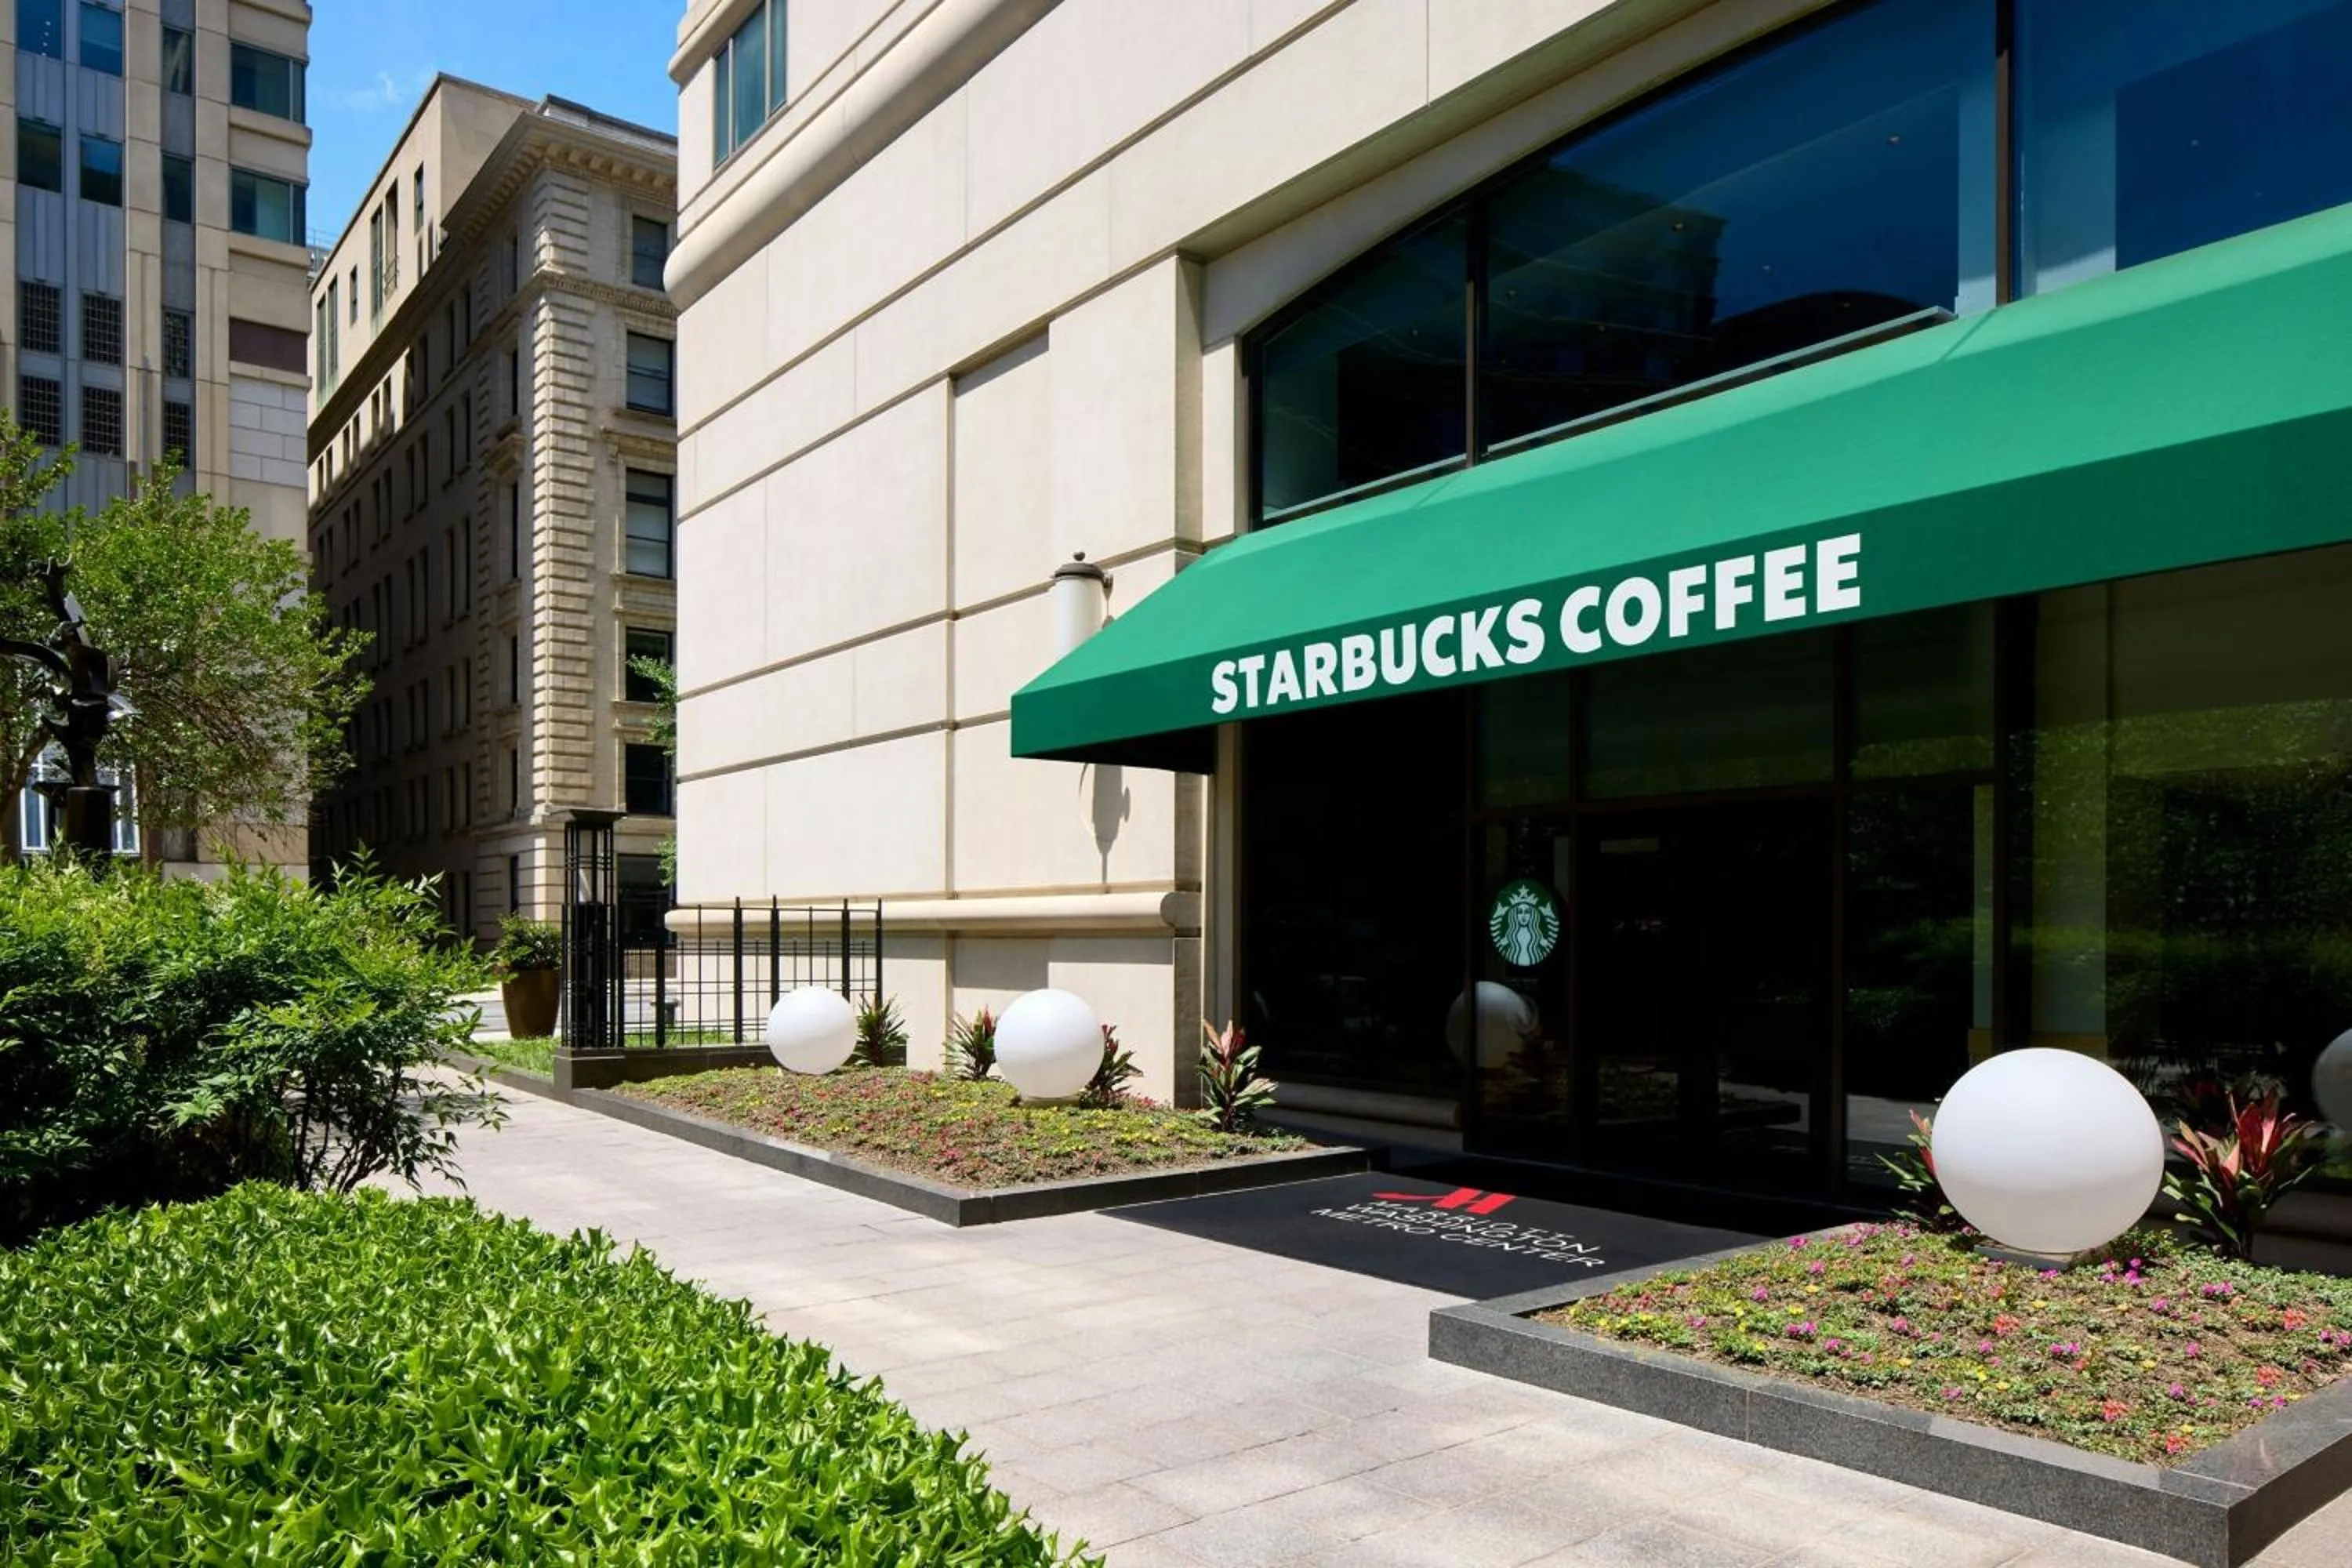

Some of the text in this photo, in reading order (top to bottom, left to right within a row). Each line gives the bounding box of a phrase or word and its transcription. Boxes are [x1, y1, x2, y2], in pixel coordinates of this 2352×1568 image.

[1211, 533, 1860, 714] STARBUCKS COFFEE
[1311, 1208, 1606, 1267] METRO CENTER
[1346, 1204, 1600, 1254] WASHINGTON
[1367, 1201, 1575, 1239] MARRIOTT
